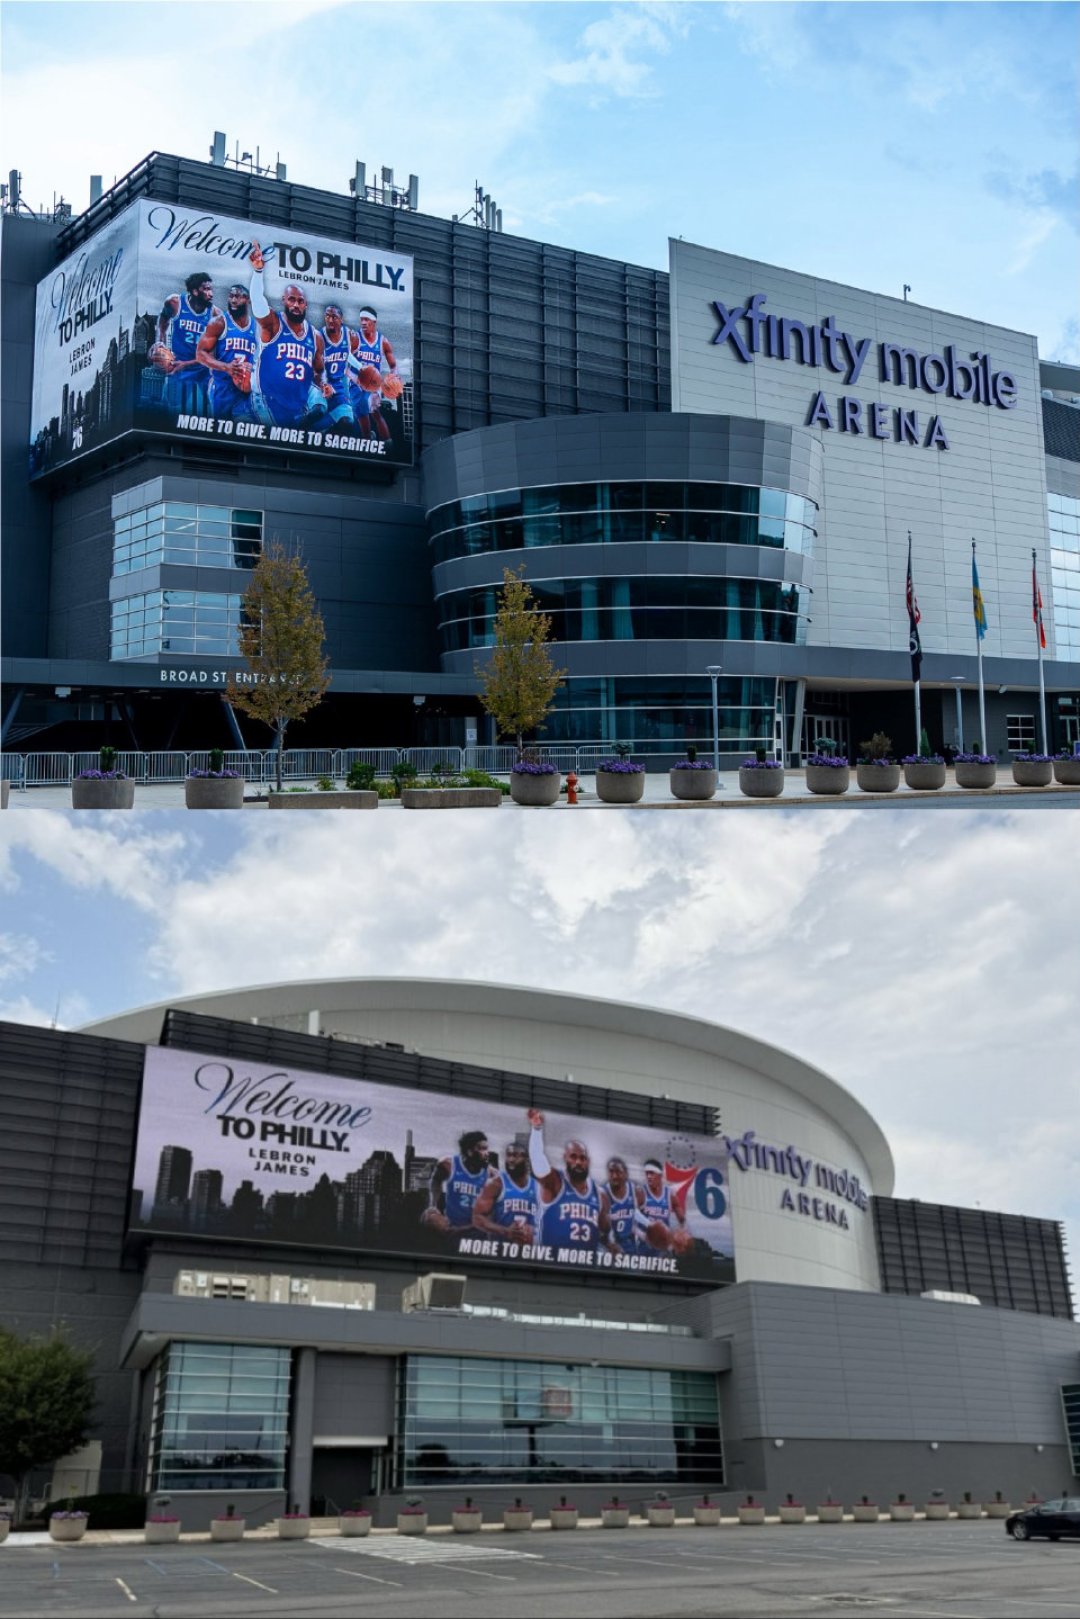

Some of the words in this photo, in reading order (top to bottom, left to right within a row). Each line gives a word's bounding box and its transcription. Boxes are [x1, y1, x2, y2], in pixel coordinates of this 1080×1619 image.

[148, 206, 275, 263] Welcome
[273, 242, 312, 272] TO
[317, 250, 405, 291] PHILLY.
[279, 270, 316, 284] LEBRON
[317, 276, 350, 291] JAMES
[51, 248, 123, 334] Welcome
[59, 313, 72, 347] TO
[74, 286, 113, 337] PHILLY.
[179, 319, 207, 334] PHIL
[68, 337, 96, 363] LEBRON
[70, 355, 93, 377] JAMES
[708, 293, 871, 385] xfinity
[877, 343, 1018, 409] mobile
[285, 361, 305, 380] 23
[330, 362, 338, 374] 0
[177, 414, 214, 432] MORE
[217, 420, 233, 434] TO
[236, 422, 267, 439] GIVE.
[269, 429, 304, 445] MORE
[307, 431, 322, 446] TO
[324, 435, 386, 455] SACRIFICE.
[805, 390, 950, 450] ARENA
[160, 670, 207, 683] BROAD
[194, 1062, 371, 1129] Welcome
[216, 1114, 255, 1139] TO
[260, 1122, 350, 1152] PHILLY.
[248, 1148, 316, 1165] LEBRON
[254, 1161, 310, 1177] JAMES
[722, 1131, 812, 1187] xfinity
[616, 1220, 625, 1232] 0
[780, 1188, 849, 1230] ARENA
[569, 1221, 591, 1241] 23
[459, 1238, 499, 1256] MORE
[502, 1242, 518, 1258] TO
[521, 1244, 554, 1262] GIVE.
[558, 1248, 593, 1265] MORE
[596, 1251, 613, 1266] TO
[614, 1254, 679, 1273] SACRIFICE.
